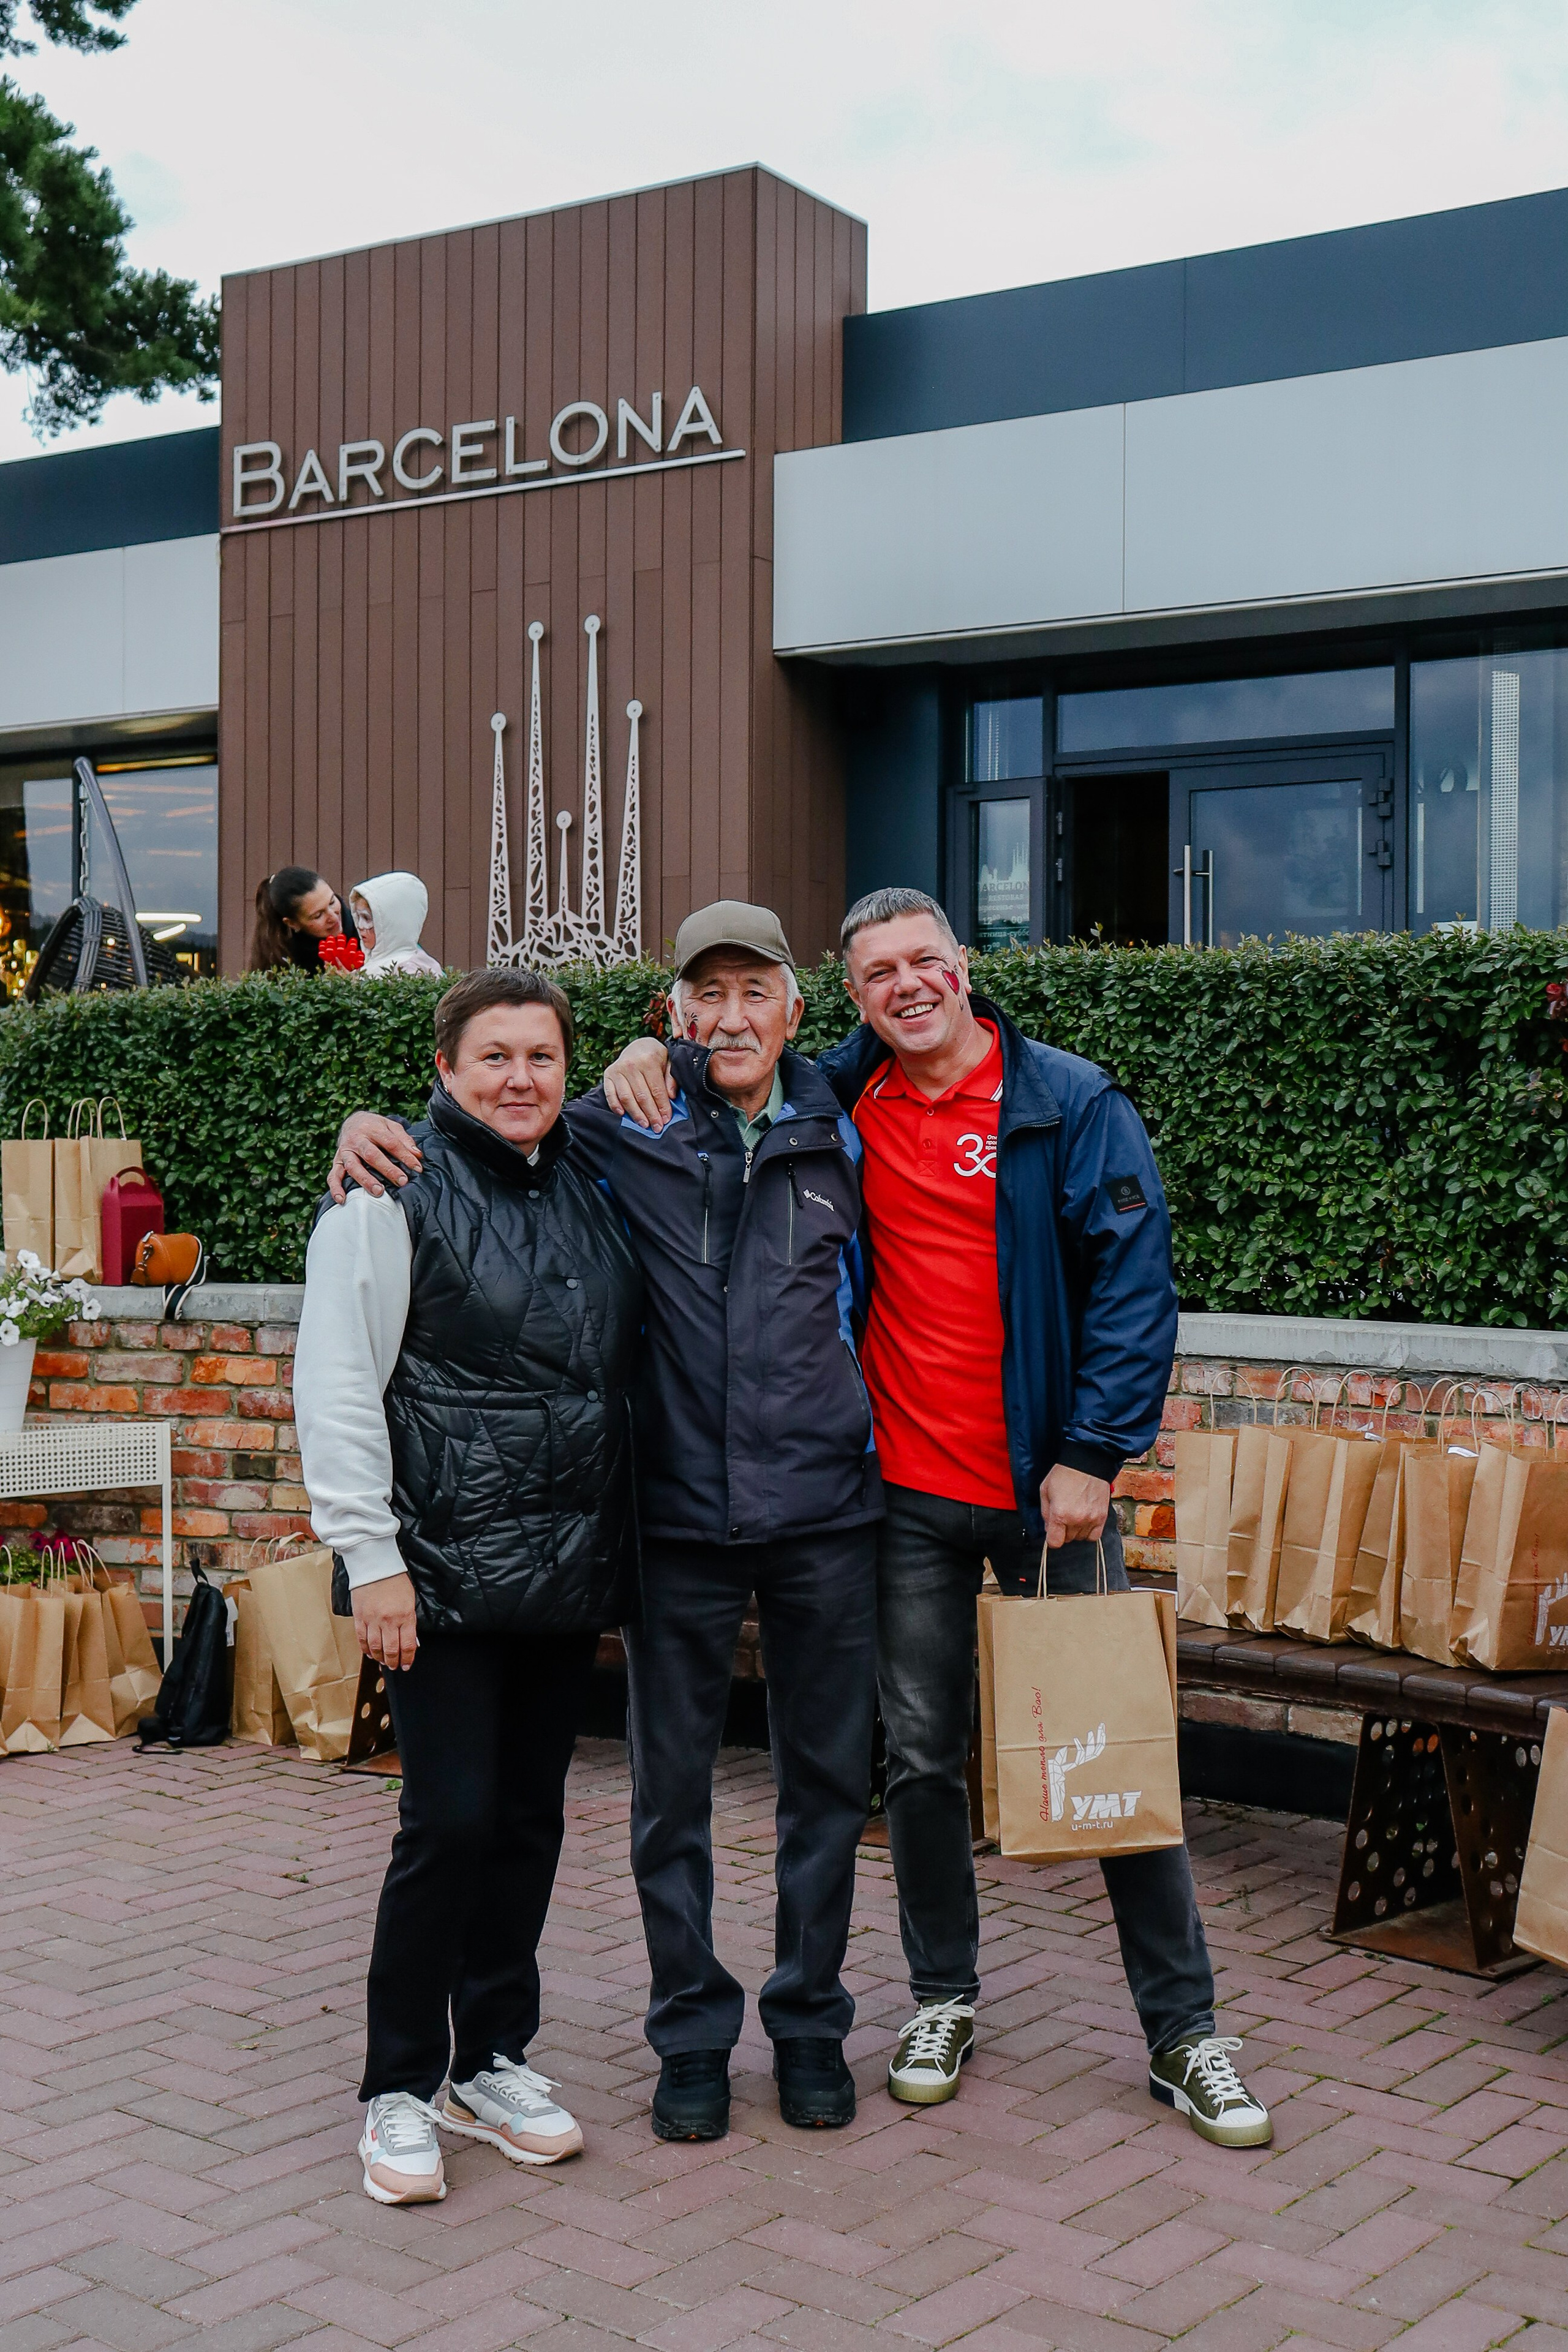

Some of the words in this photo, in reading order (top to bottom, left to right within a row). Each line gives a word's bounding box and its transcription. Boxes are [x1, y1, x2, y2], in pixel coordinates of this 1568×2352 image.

[233, 385, 723, 518] BARCELONA
[1031, 1686, 1042, 1719] Вас!
[1038, 1722, 1047, 1742] для
[1039, 1784, 1049, 1822] Наше
[1070, 1790, 1142, 1821] УМТ
[1071, 1820, 1114, 1831] u-m-t.ru
